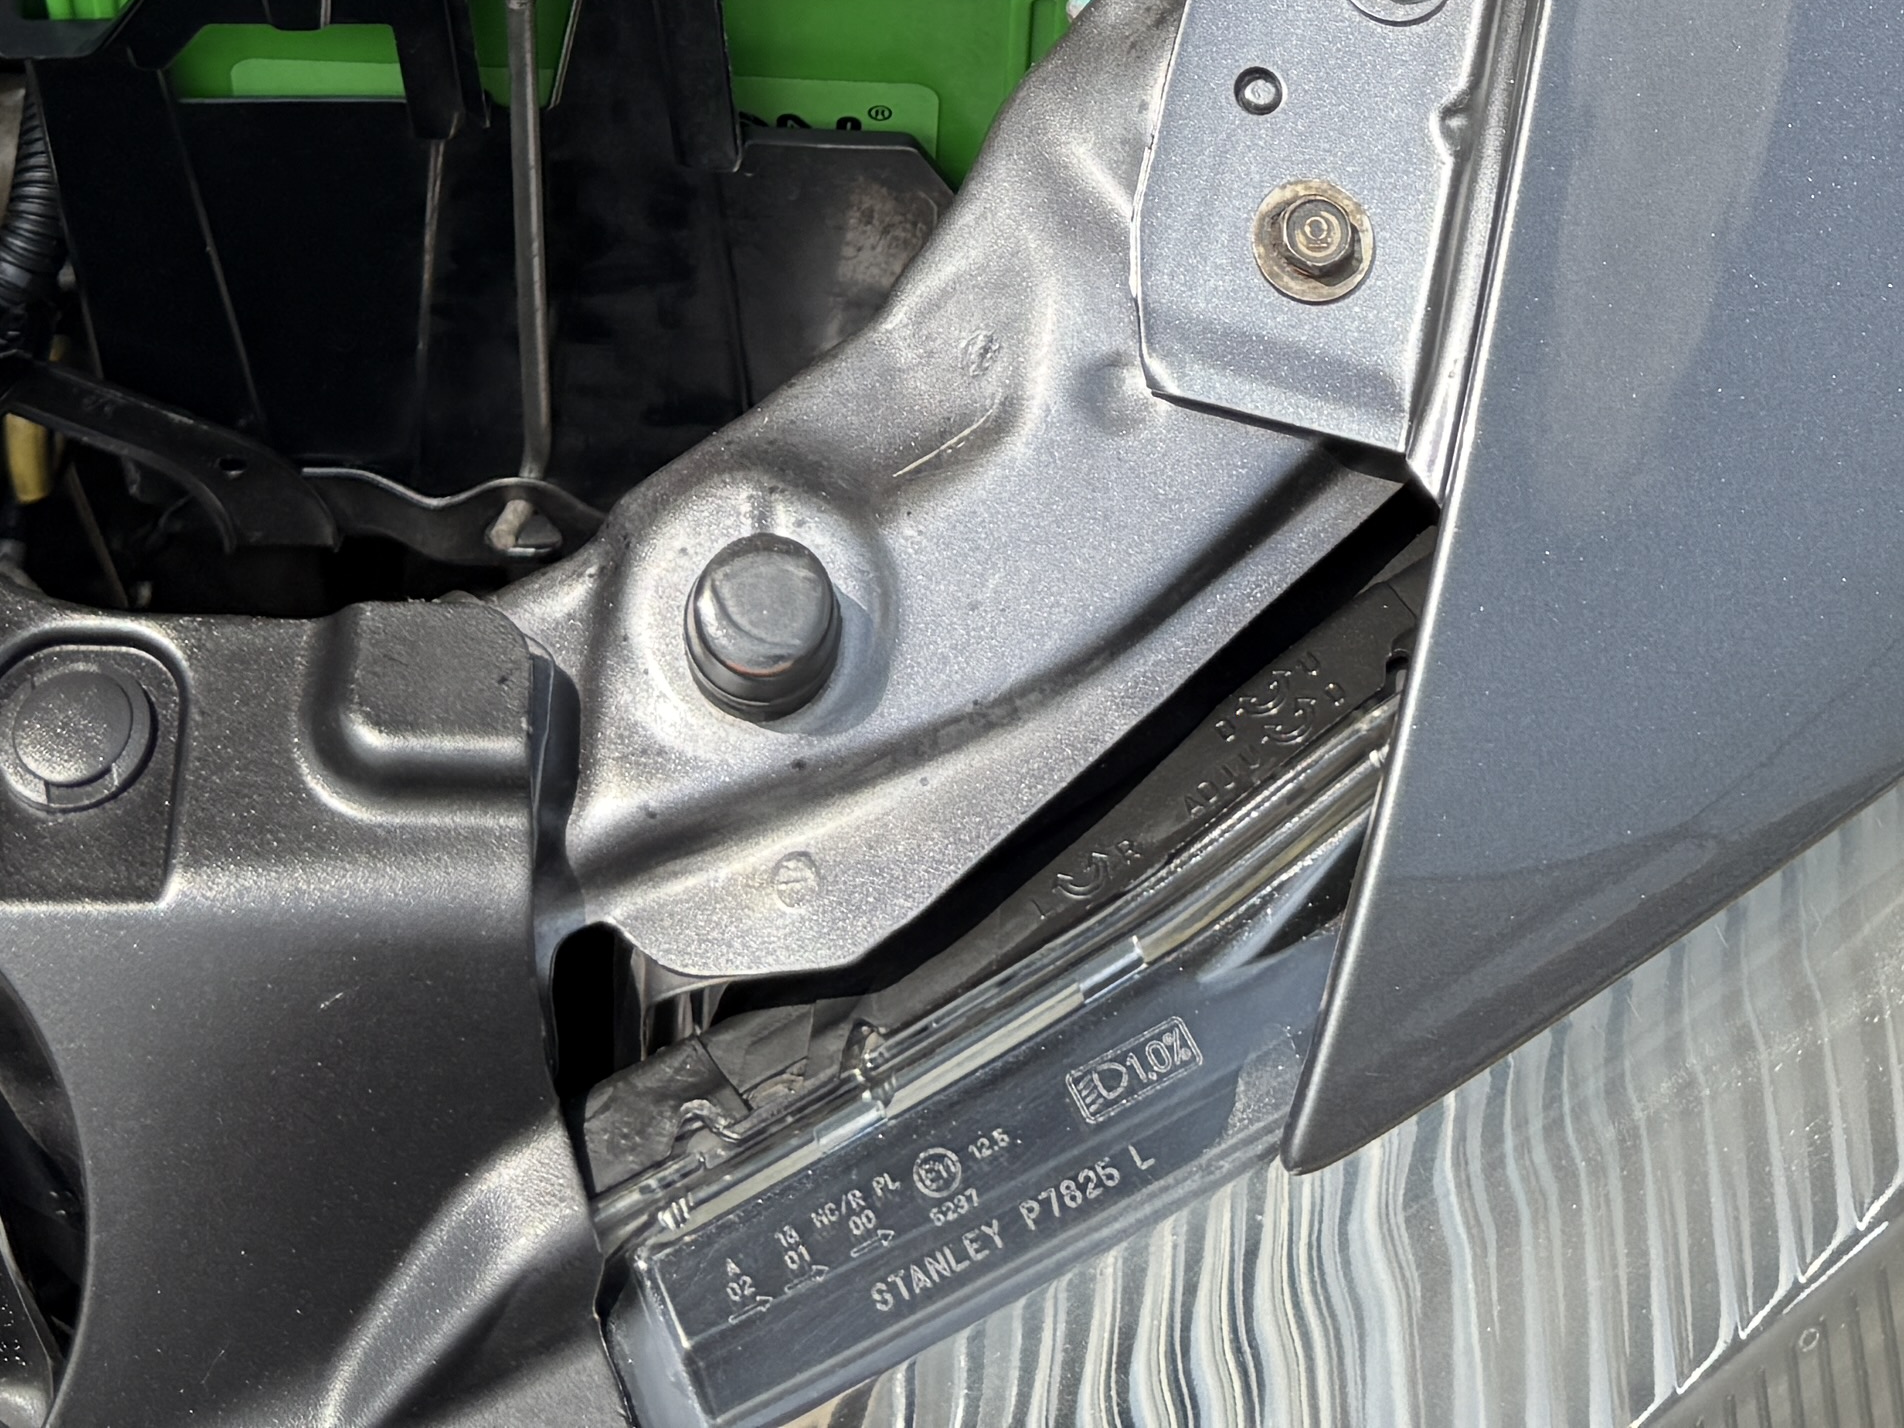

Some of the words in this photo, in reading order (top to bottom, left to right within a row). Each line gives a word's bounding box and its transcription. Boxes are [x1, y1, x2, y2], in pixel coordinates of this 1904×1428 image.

[1126, 1027, 1192, 1083] 1.0%
[872, 1172, 901, 1197] PL
[848, 1209, 877, 1236] 00
[870, 1219, 1003, 1312] STANLEY
[1128, 1144, 1156, 1170] L
[784, 1244, 811, 1270] 01
[726, 1275, 756, 1302] 02
